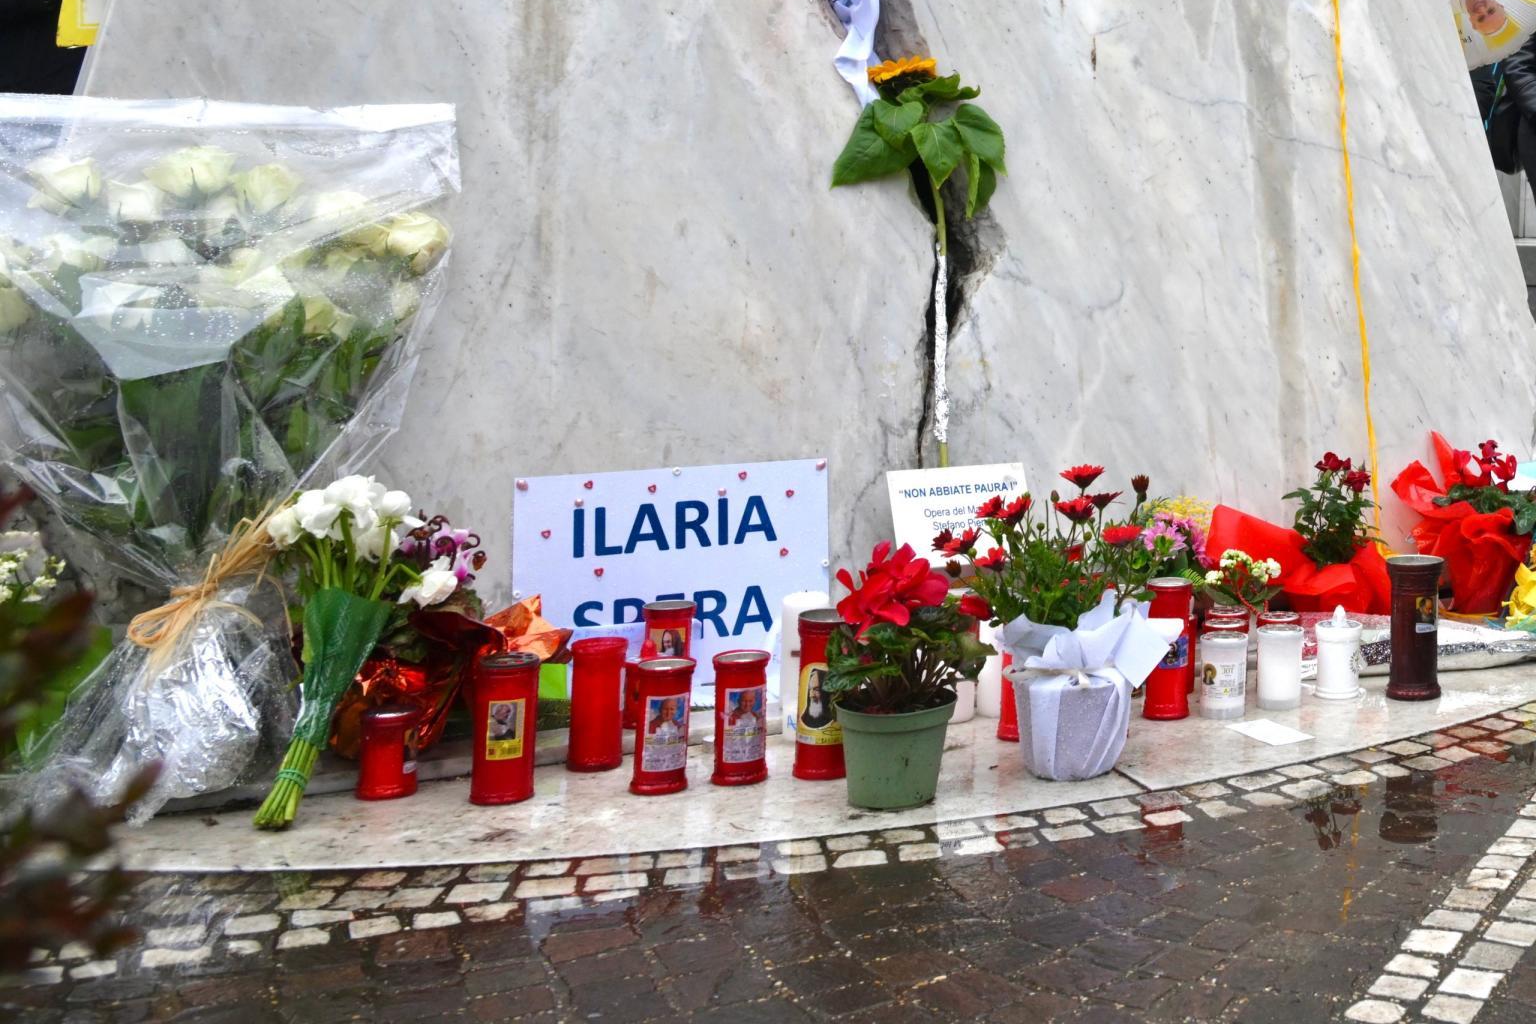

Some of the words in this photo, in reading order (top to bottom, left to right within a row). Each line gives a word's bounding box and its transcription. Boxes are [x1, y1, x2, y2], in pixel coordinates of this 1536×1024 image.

[929, 484, 972, 497] ABBIATE
[974, 482, 1009, 493] PAURA
[924, 507, 950, 521] Opera
[952, 505, 966, 515] del
[573, 495, 777, 558] ILARIA
[933, 520, 966, 531] Stefano
[573, 585, 773, 640] SPRA
